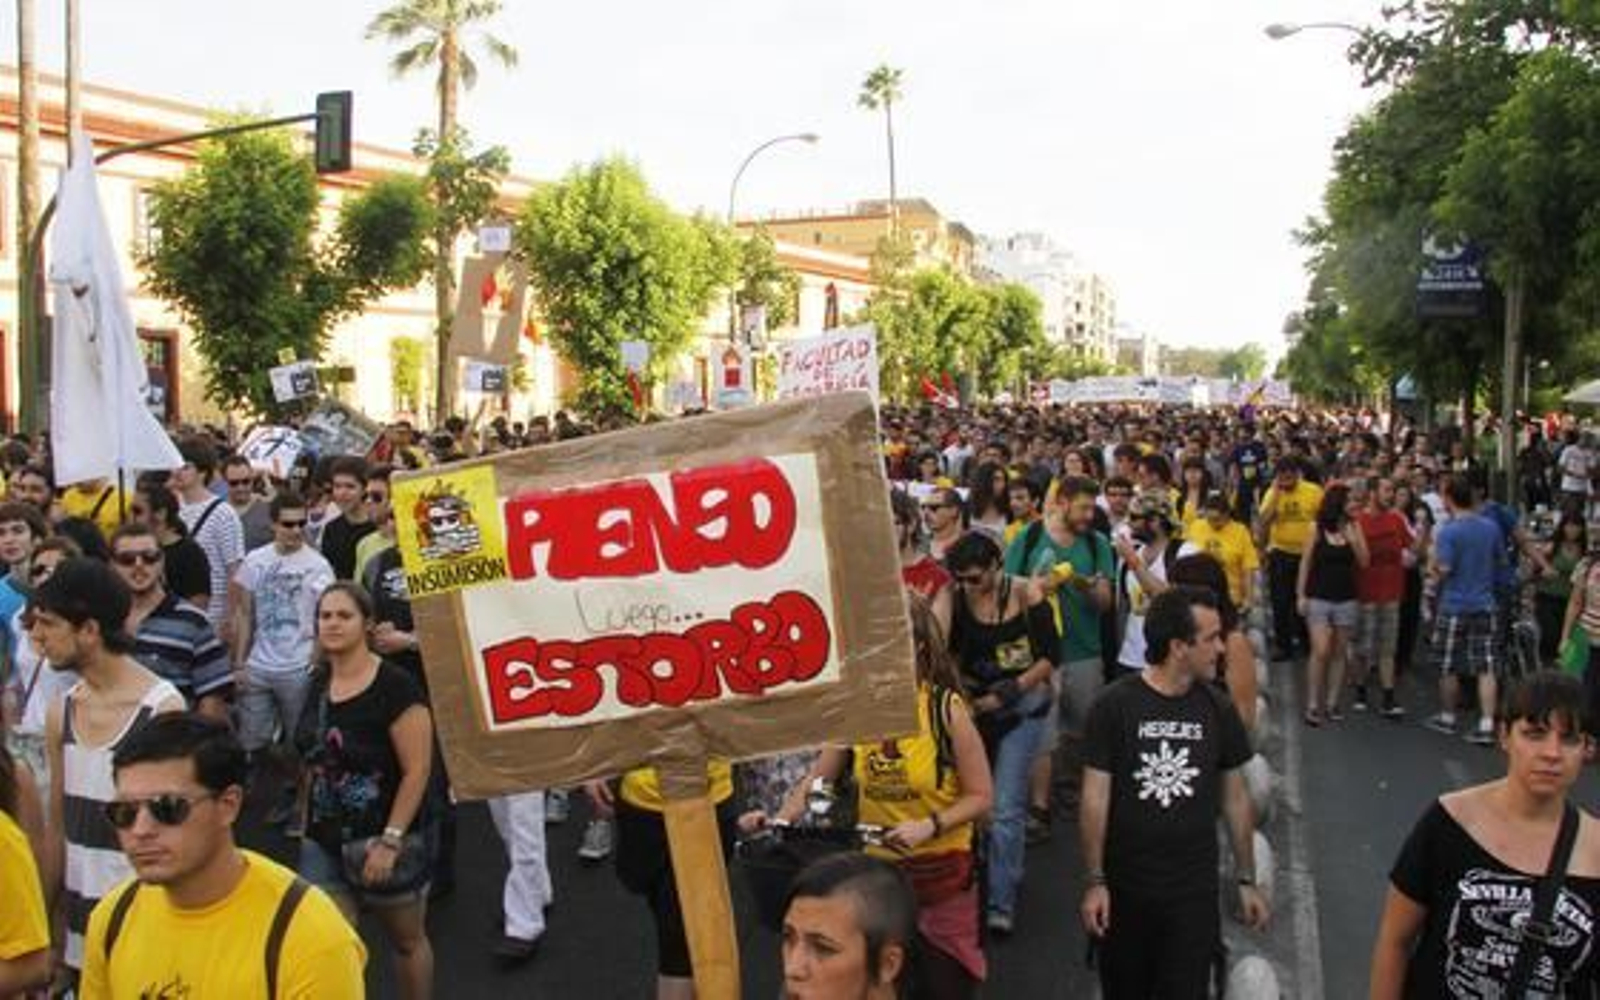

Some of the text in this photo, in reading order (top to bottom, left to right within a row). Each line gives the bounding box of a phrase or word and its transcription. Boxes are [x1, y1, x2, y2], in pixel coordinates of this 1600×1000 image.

[782, 338, 870, 376] FACULTAD
[504, 457, 797, 580] PIENSO
[482, 590, 831, 725] ESTORBO
